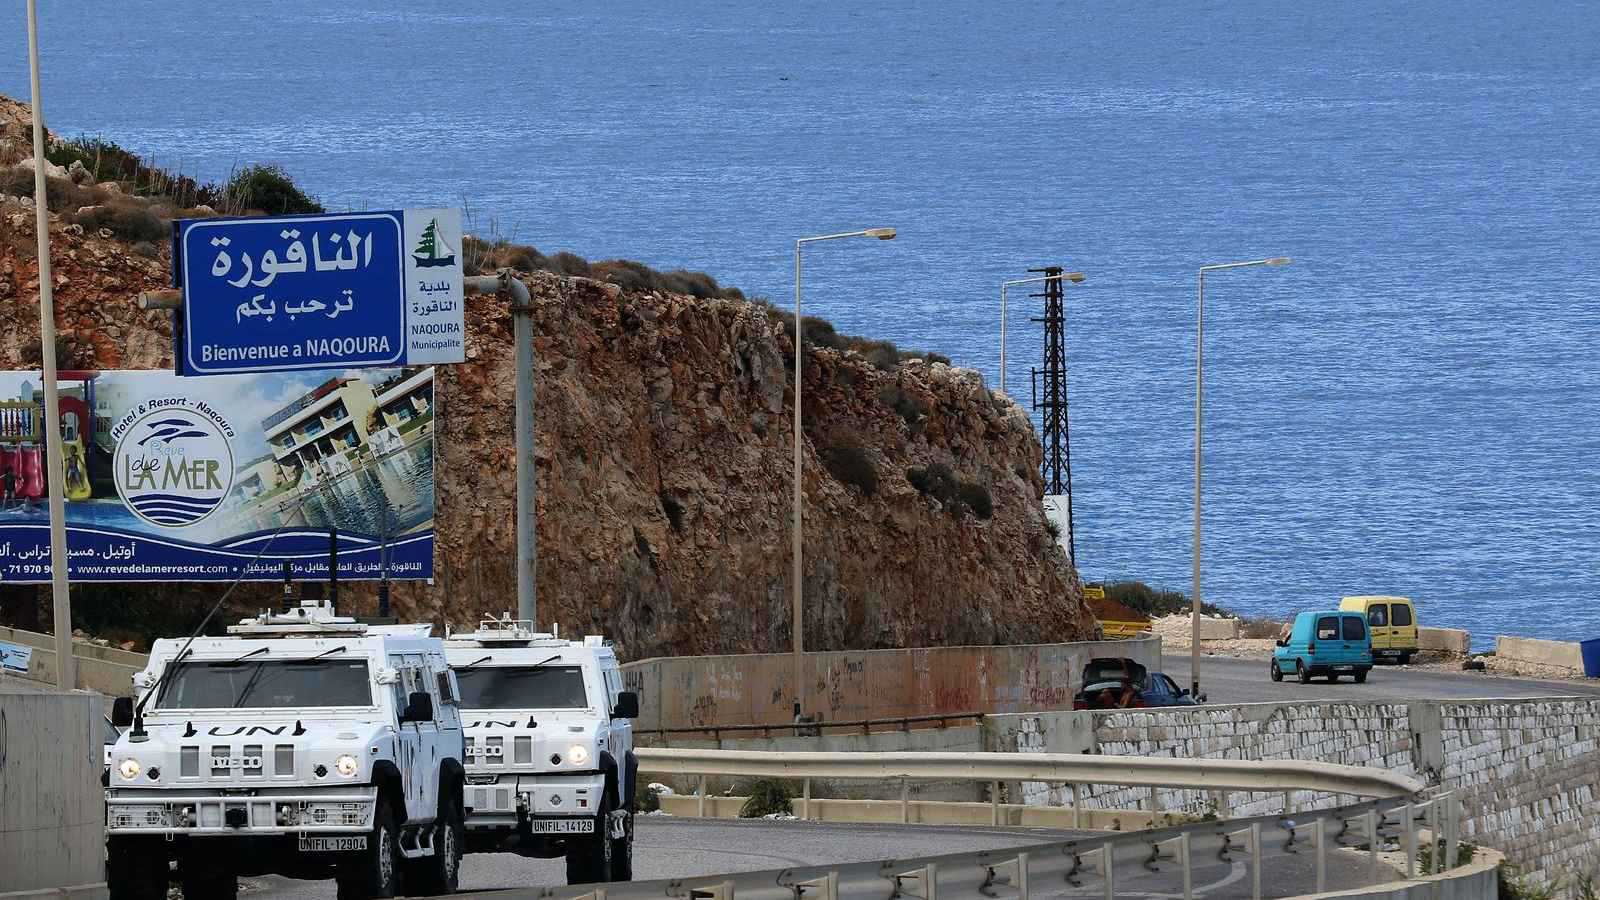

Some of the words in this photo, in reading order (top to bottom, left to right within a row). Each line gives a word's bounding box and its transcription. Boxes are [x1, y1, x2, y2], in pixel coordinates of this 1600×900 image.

[210, 229, 373, 288] الناقورة
[419, 280, 450, 295] بلدية
[236, 294, 276, 324] بكم
[284, 289, 354, 319] ترحب
[412, 300, 457, 316] الناقورة
[411, 322, 460, 335] NAQOURA
[202, 344, 289, 362] Bienvenue
[292, 344, 301, 357] a
[306, 335, 391, 357] NAQOURA
[112, 410, 136, 439] Hotel
[138, 405, 146, 415] &
[148, 397, 187, 410] Resort
[196, 402, 235, 438] Naqoura
[132, 454, 160, 471] de
[125, 454, 156, 490] LA
[162, 456, 222, 490] MER
[18, 544, 51, 560] تراس
[66, 547, 95, 559] مسب
[102, 541, 136, 559] أوتيل
[9, 565, 20, 573] 71
[23, 565, 41, 574] 970
[77, 564, 228, 574] www.revedelamerresort.com
[336, 563, 352, 571] العا
[391, 562, 422, 573] الناقورة
[208, 726, 287, 736] UN
